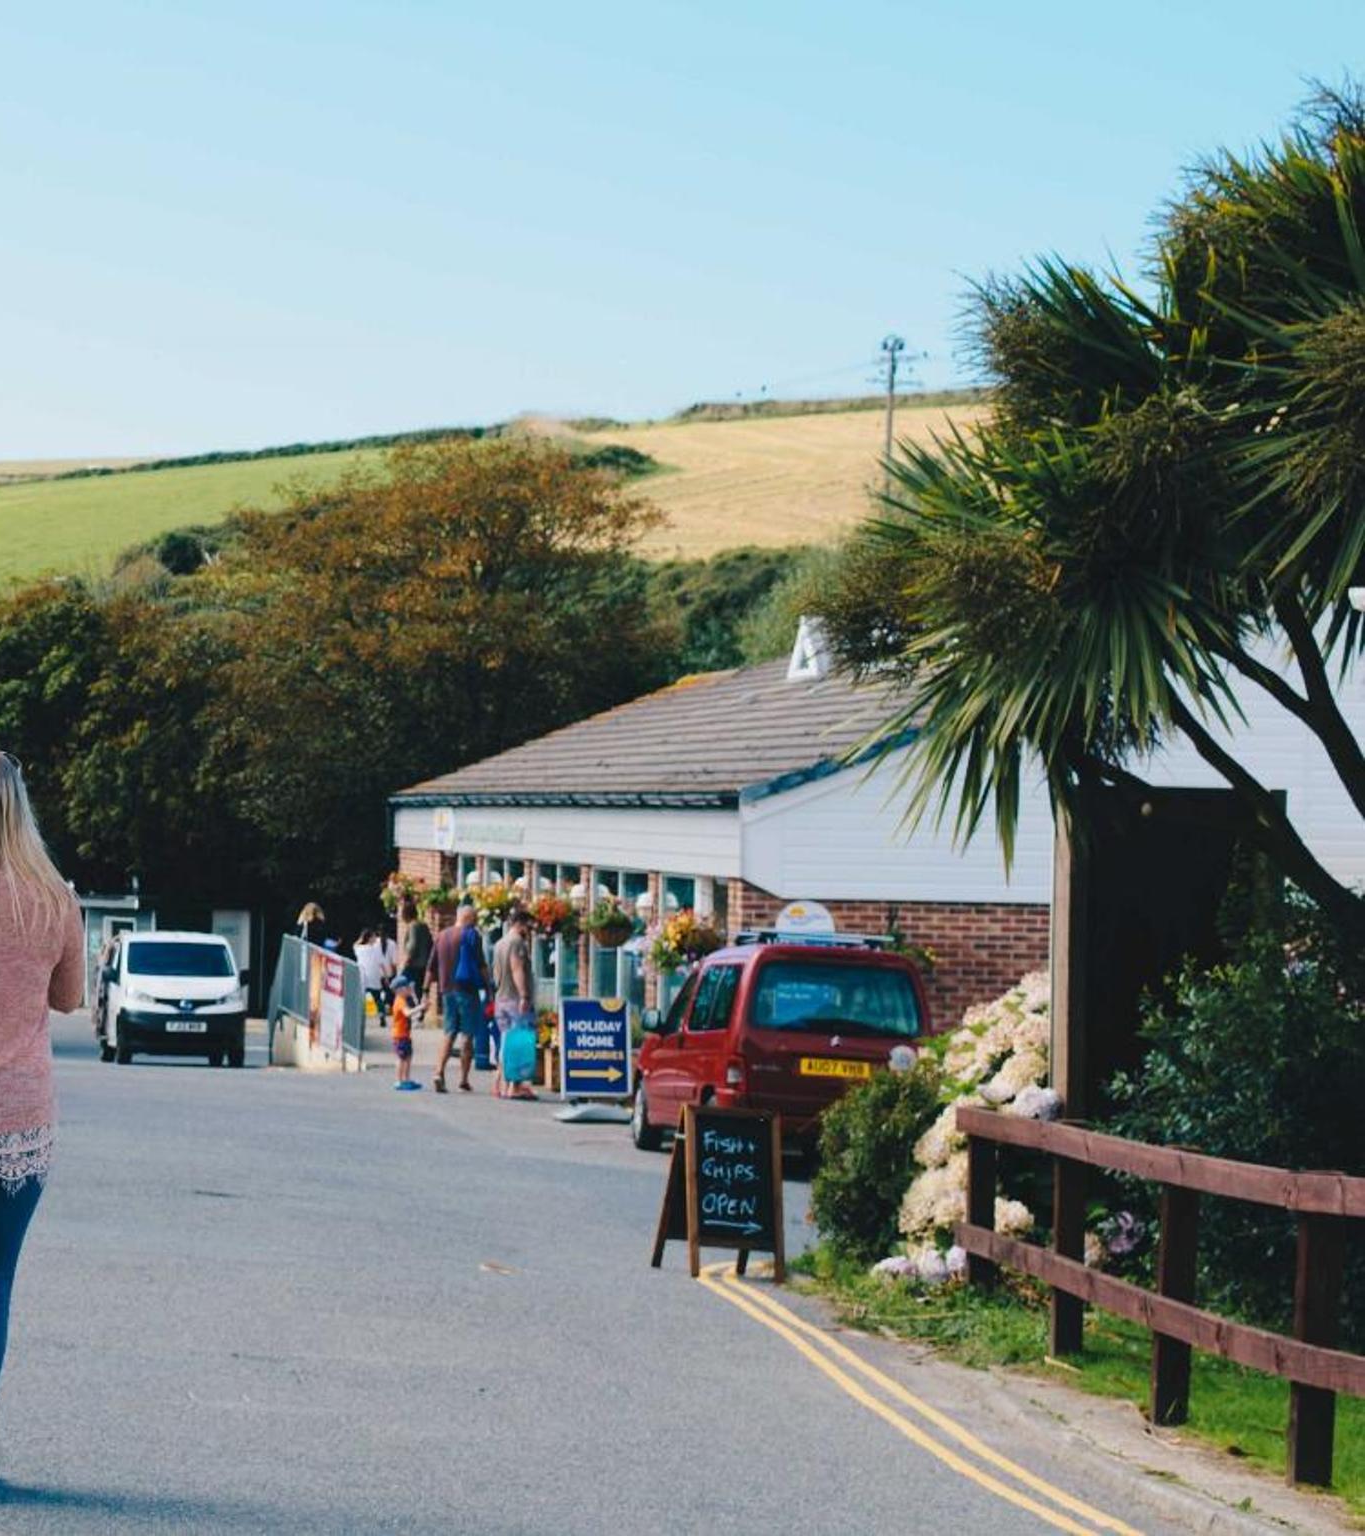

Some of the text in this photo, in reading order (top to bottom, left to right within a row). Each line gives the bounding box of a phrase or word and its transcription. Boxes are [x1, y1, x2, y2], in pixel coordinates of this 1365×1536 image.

[568, 1021, 622, 1032] HOLIDAY
[577, 1035, 614, 1047] HOME
[702, 1193, 756, 1215] OPEN
